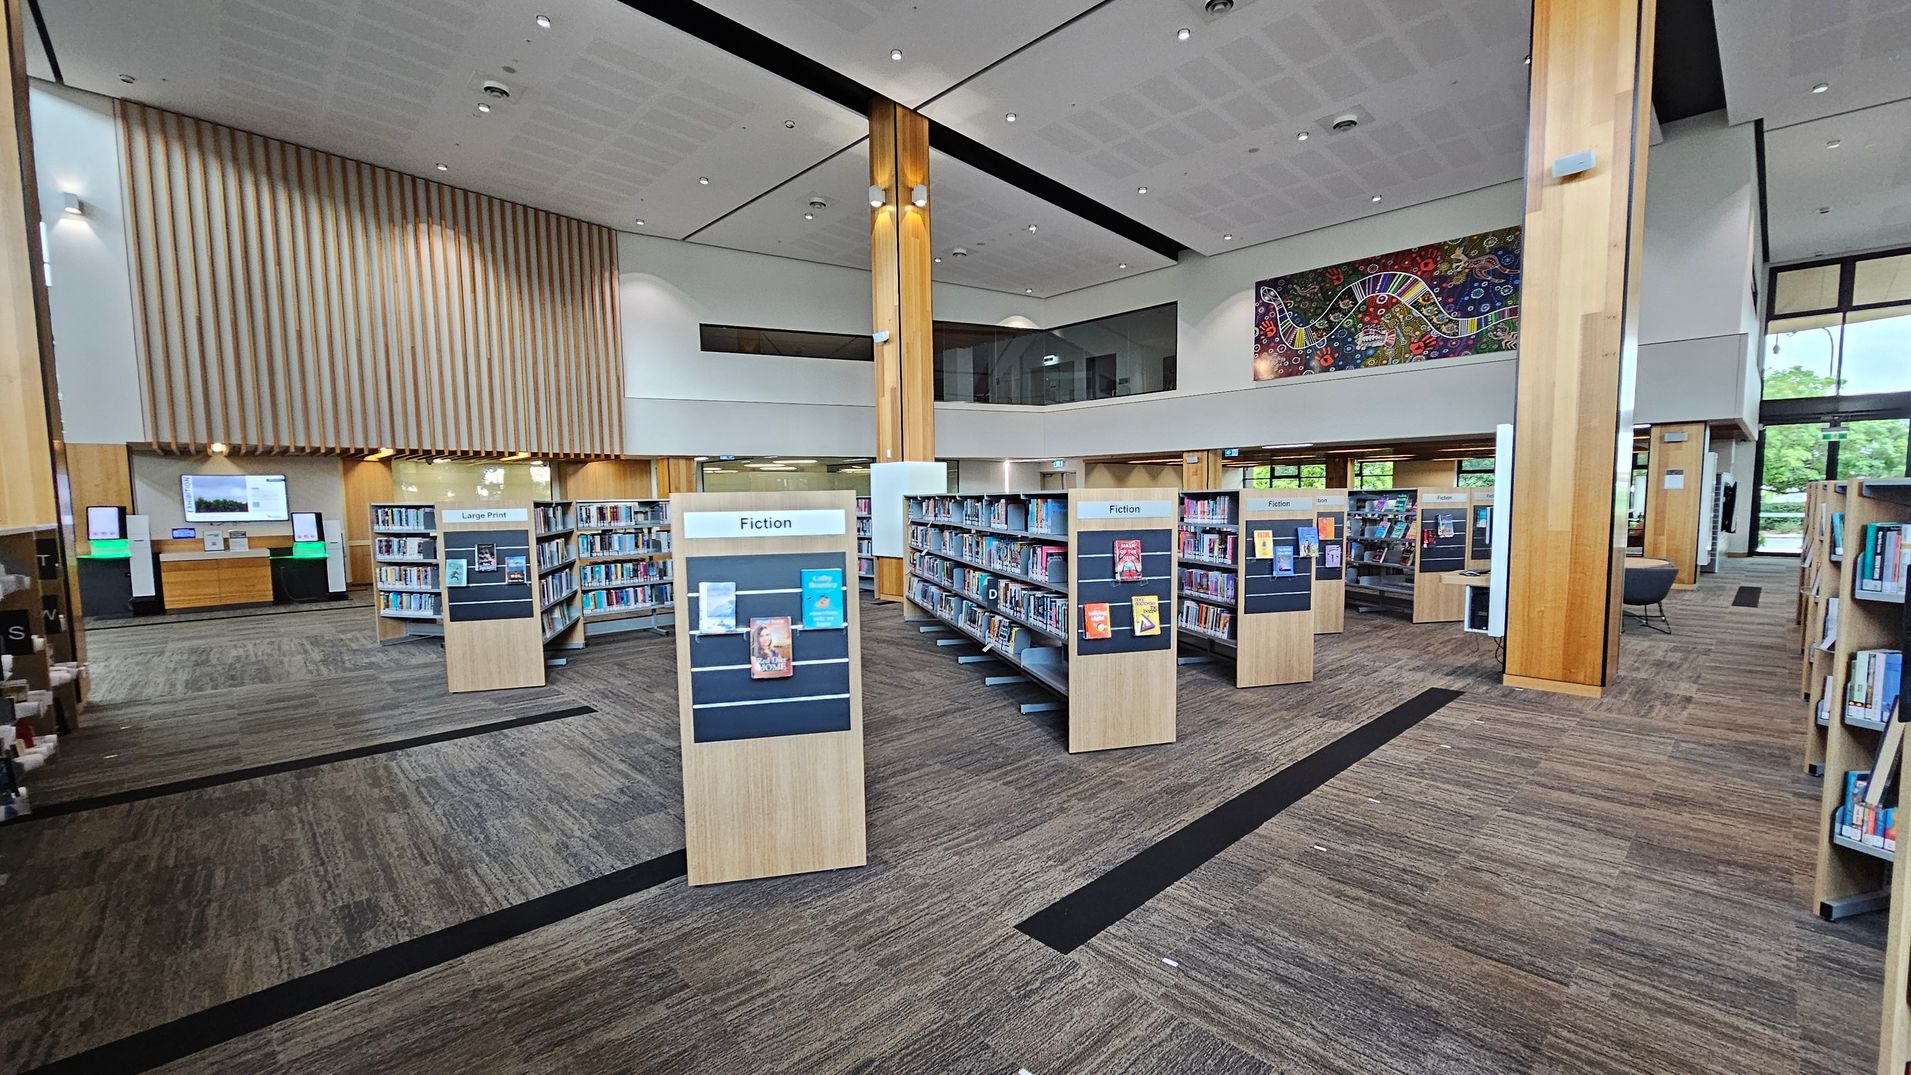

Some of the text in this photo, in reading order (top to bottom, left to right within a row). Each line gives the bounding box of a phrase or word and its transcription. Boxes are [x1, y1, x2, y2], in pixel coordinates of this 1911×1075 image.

[1109, 504, 1141, 514] Fiction
[462, 511, 507, 520] Large Print
[740, 517, 792, 530] Fiction
[988, 588, 998, 600] D
[8, 625, 25, 640] S
